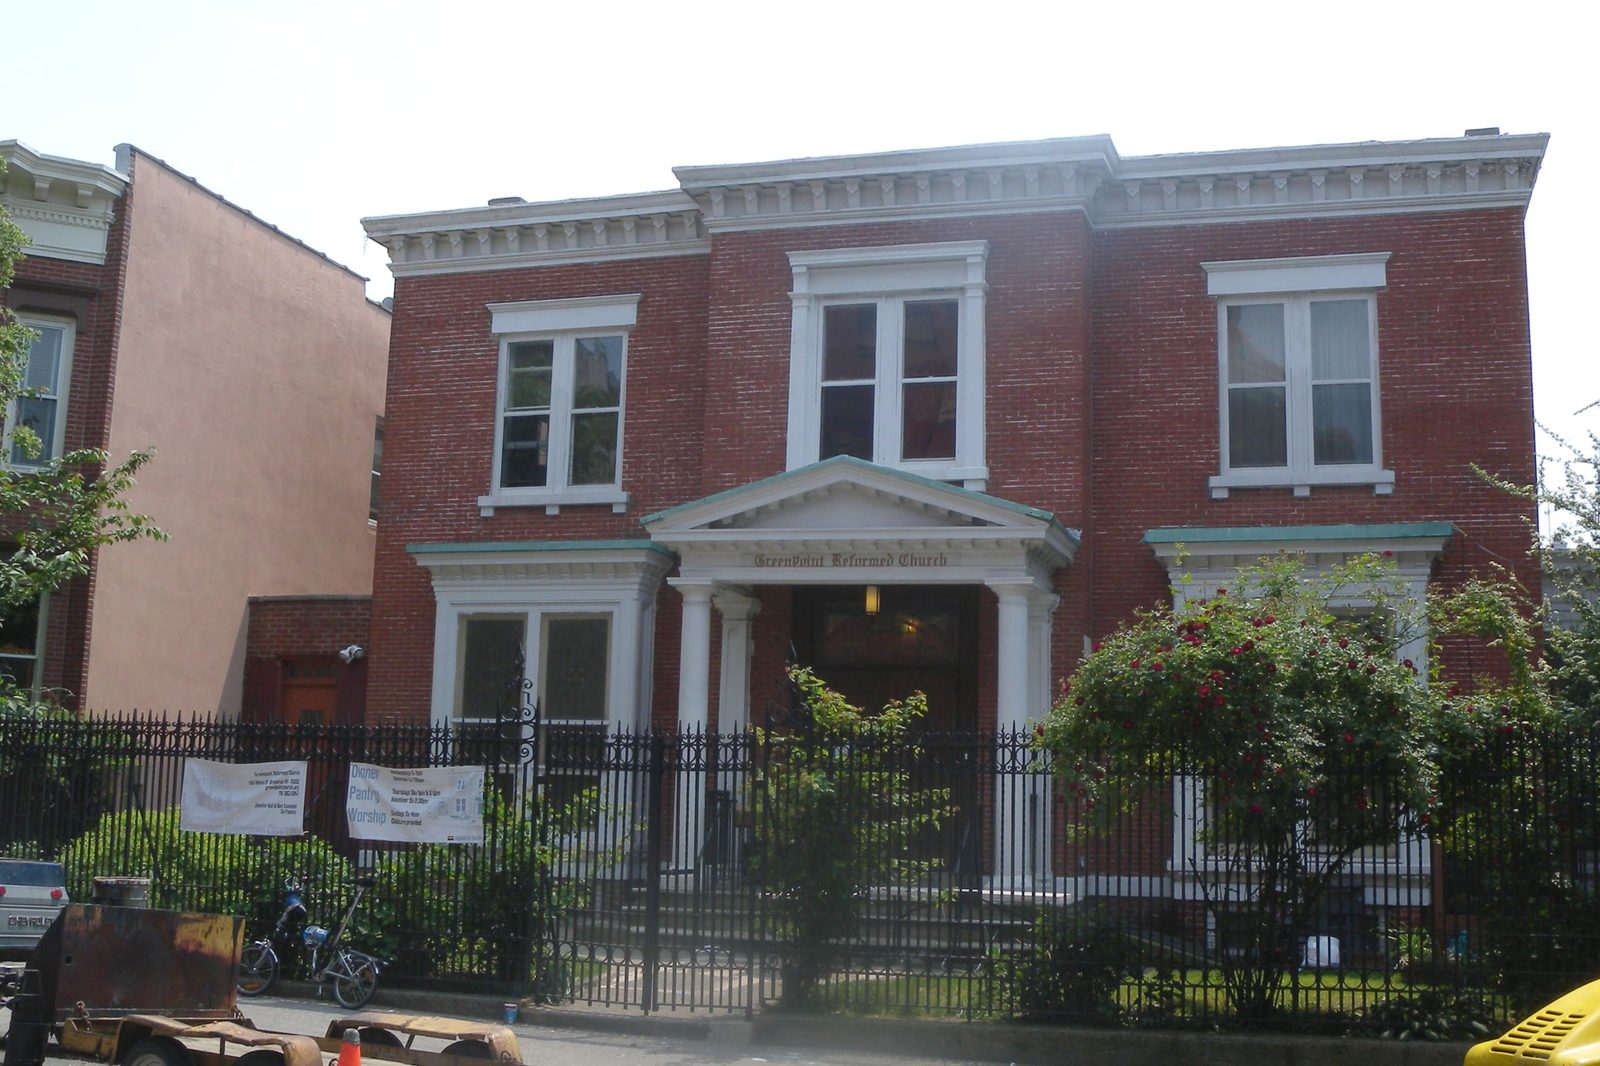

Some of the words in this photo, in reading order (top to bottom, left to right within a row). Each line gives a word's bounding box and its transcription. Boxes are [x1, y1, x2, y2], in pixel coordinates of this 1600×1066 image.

[832, 553, 894, 567] Reformed
[899, 552, 947, 567] Church
[349, 785, 380, 803] Pantry
[348, 807, 386, 825] Worship
